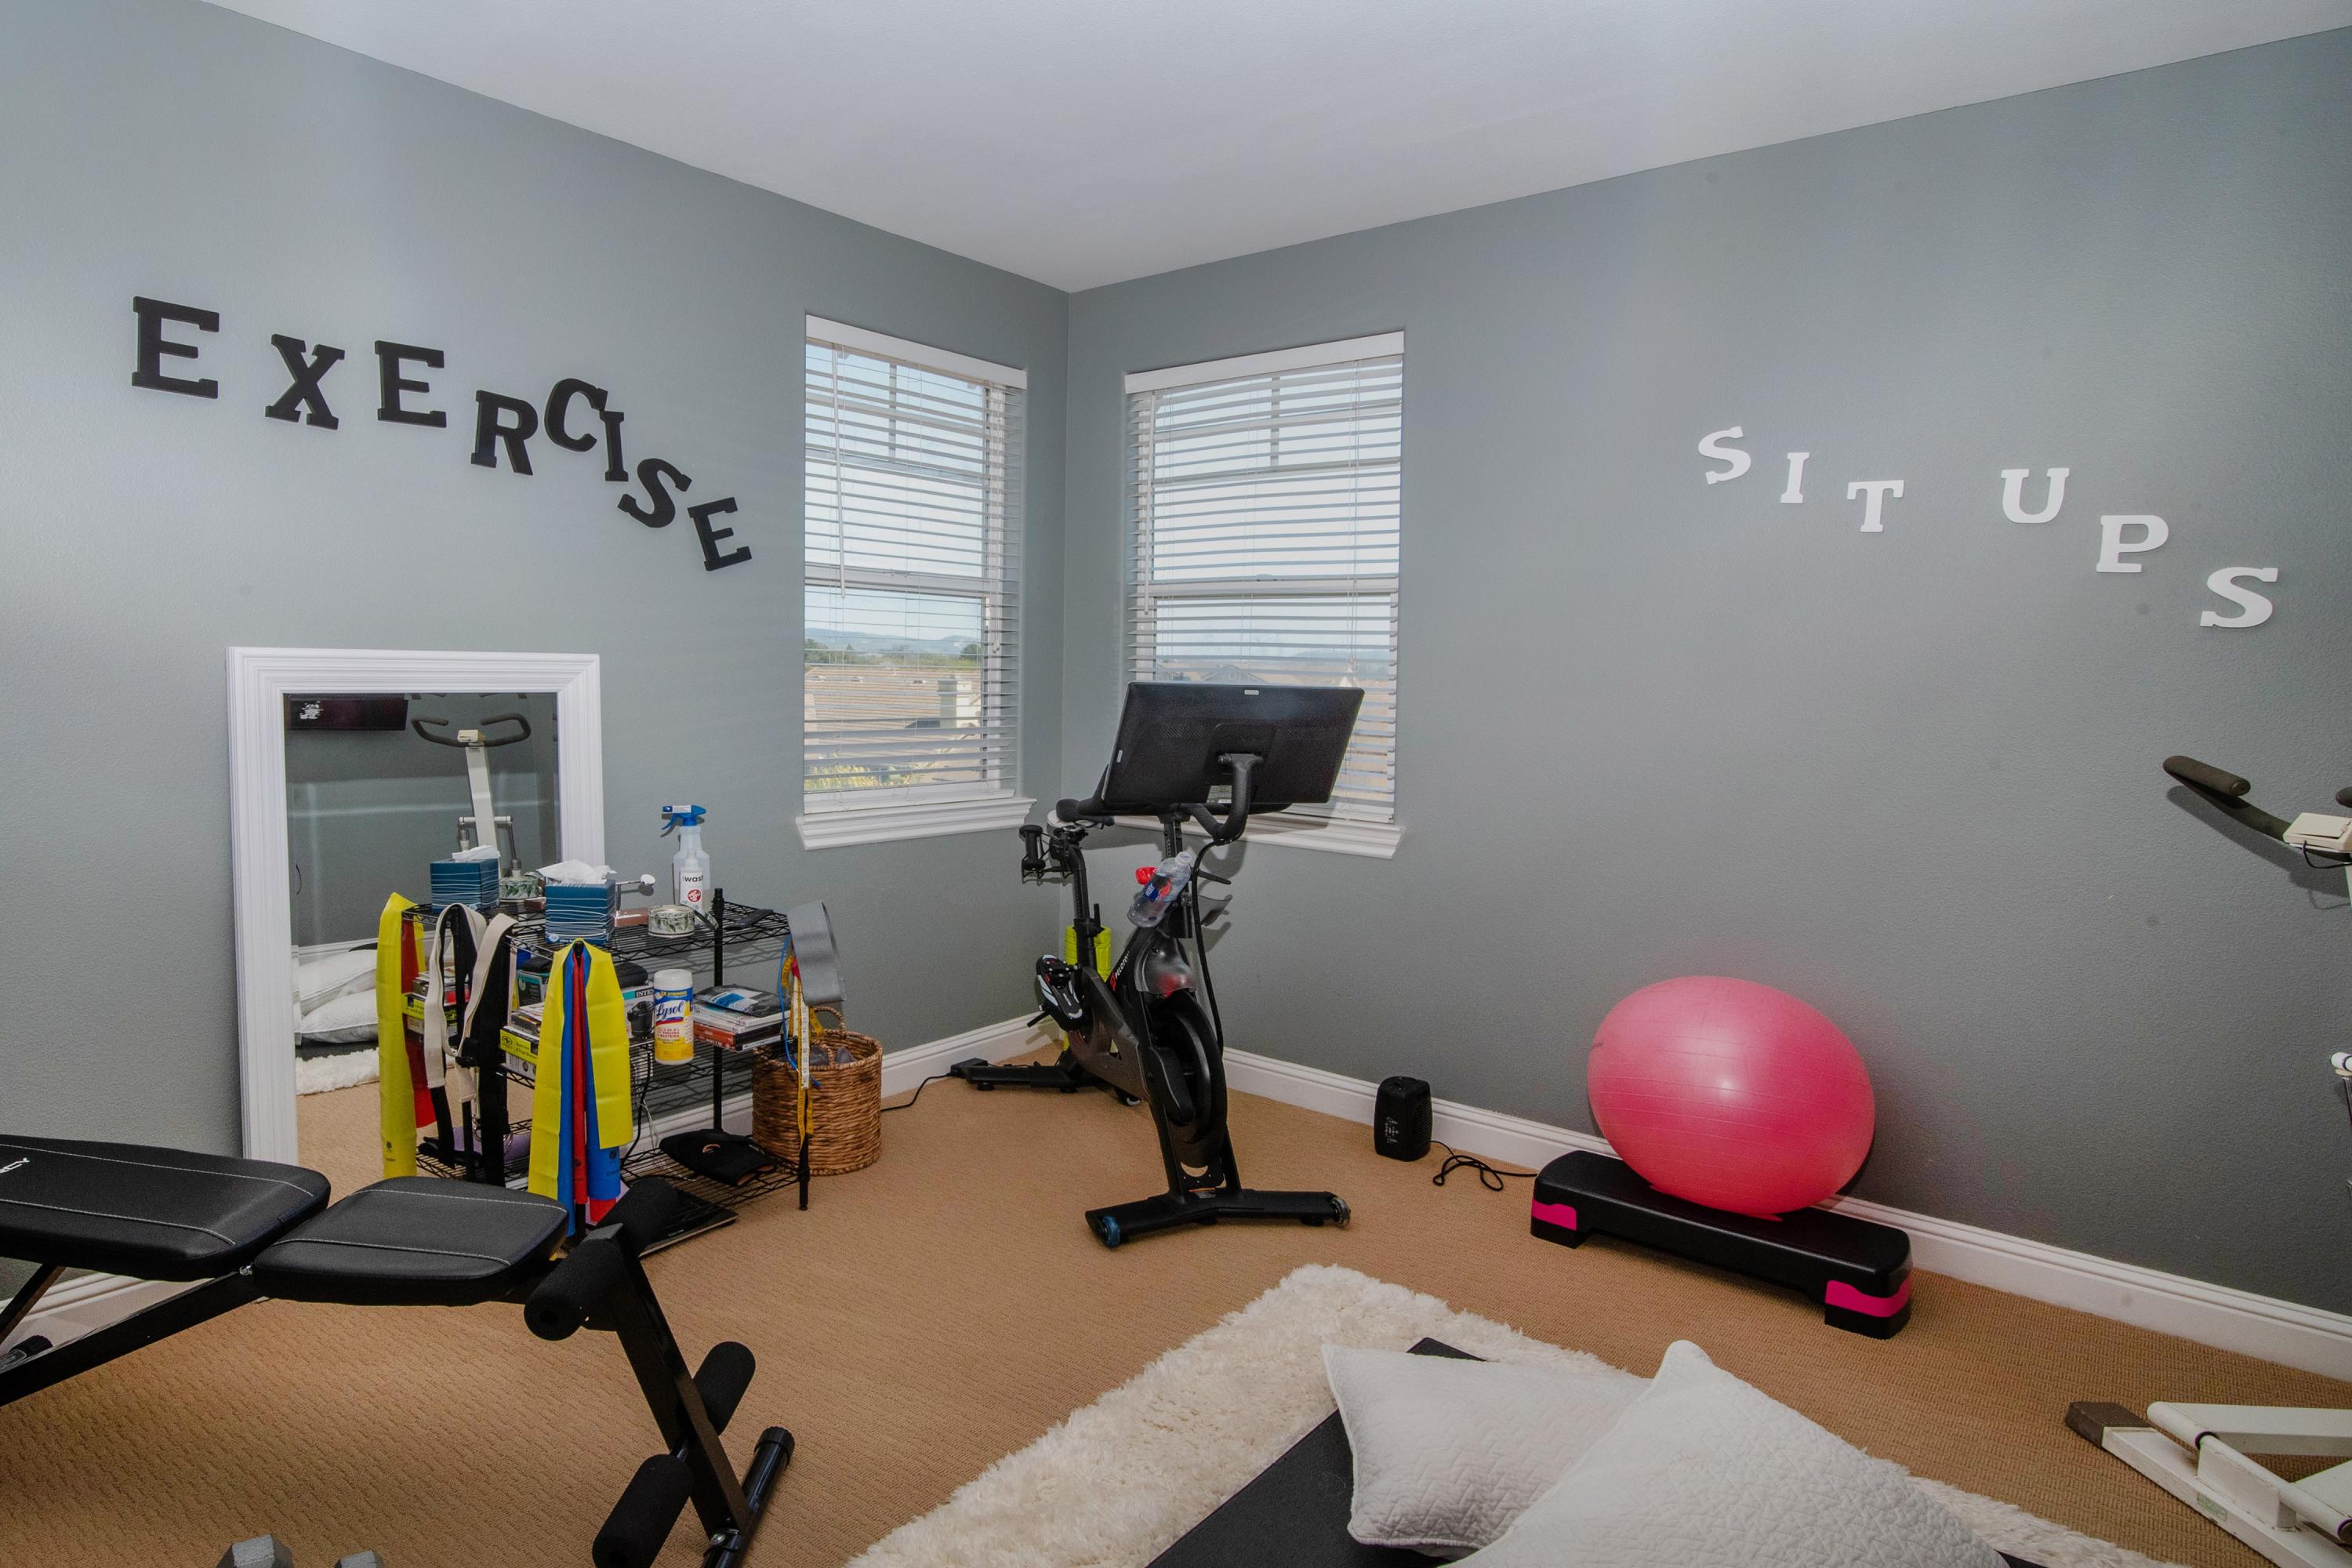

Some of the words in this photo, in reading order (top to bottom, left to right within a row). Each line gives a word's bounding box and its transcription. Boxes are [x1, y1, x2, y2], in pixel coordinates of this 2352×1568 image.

[131, 296, 753, 572] EXERCISE
[1697, 425, 1905, 533] SIT
[2000, 466, 2279, 629] UPS
[636, 989, 654, 997] INTE
[656, 1001, 684, 1019] Lysol
